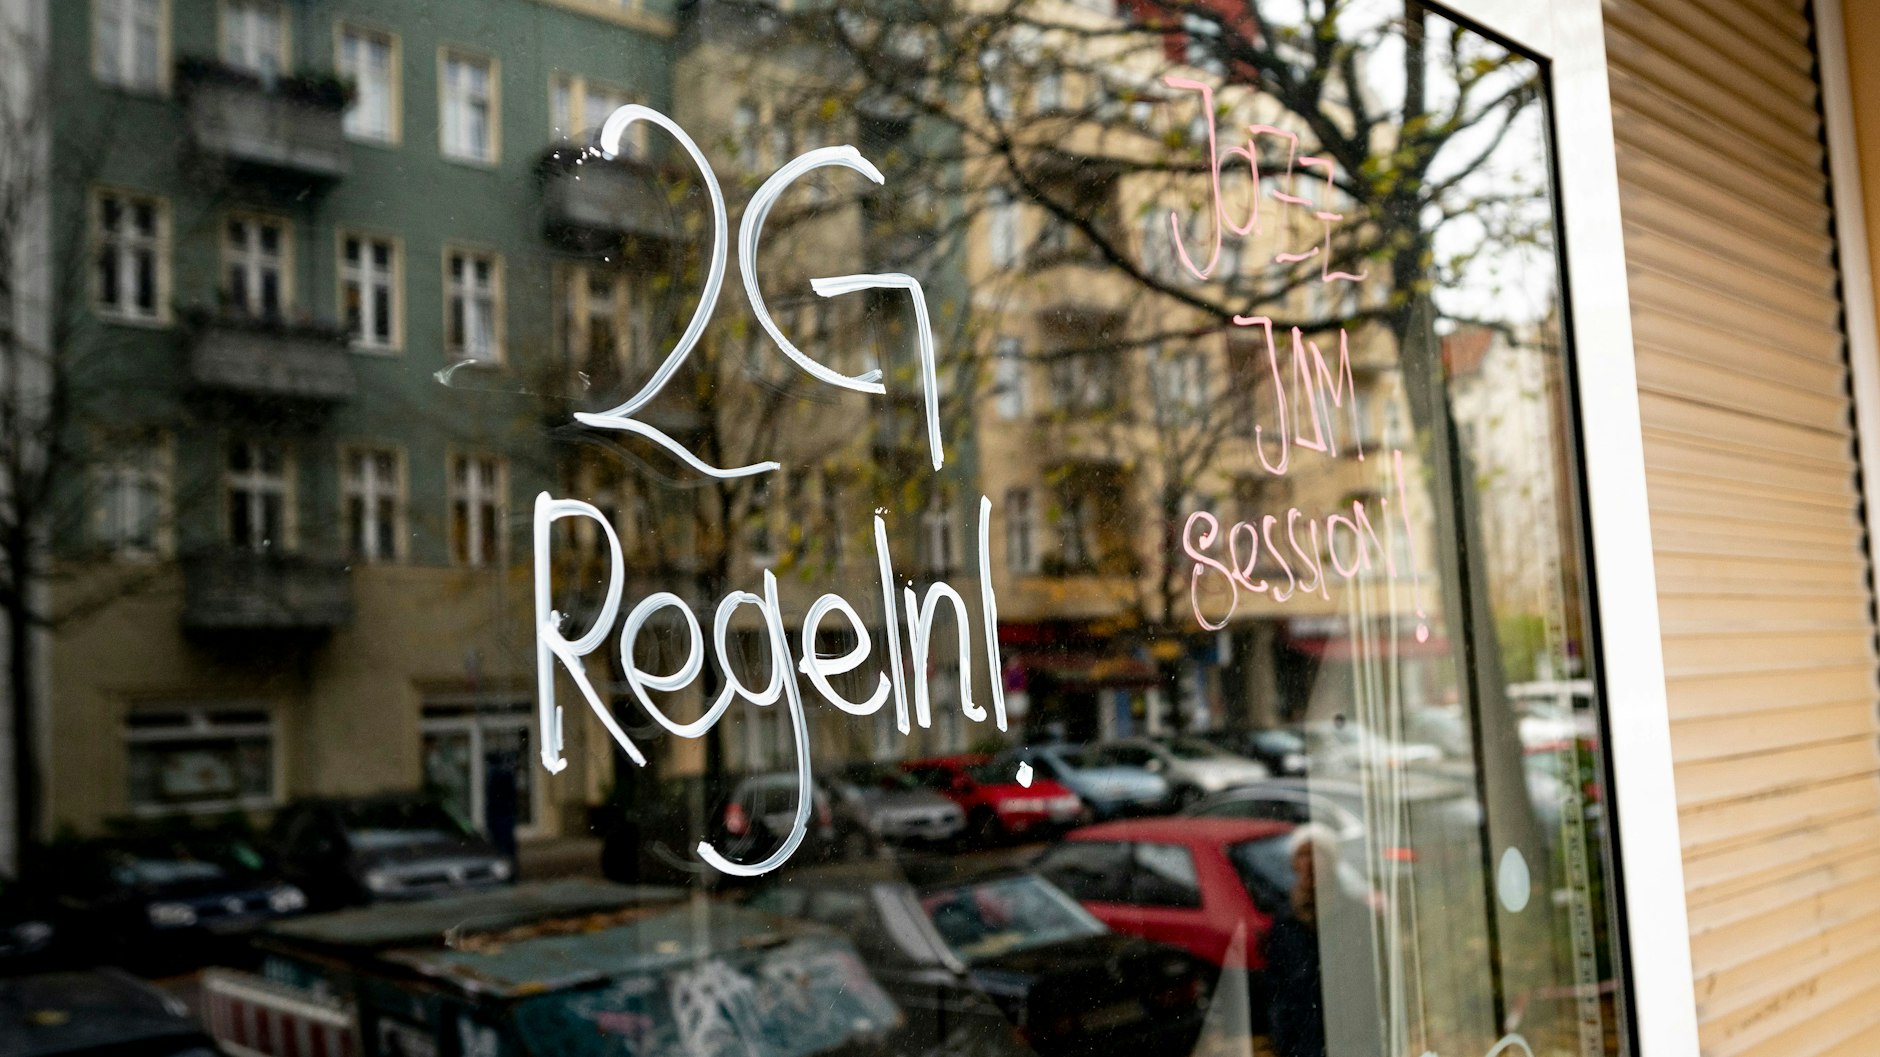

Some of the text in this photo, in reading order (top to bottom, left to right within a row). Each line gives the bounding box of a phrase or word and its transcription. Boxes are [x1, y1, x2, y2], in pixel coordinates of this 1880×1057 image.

[574, 103, 945, 478] 2G
[1232, 314, 1365, 476] JAM
[533, 490, 1034, 876] Regeln!
